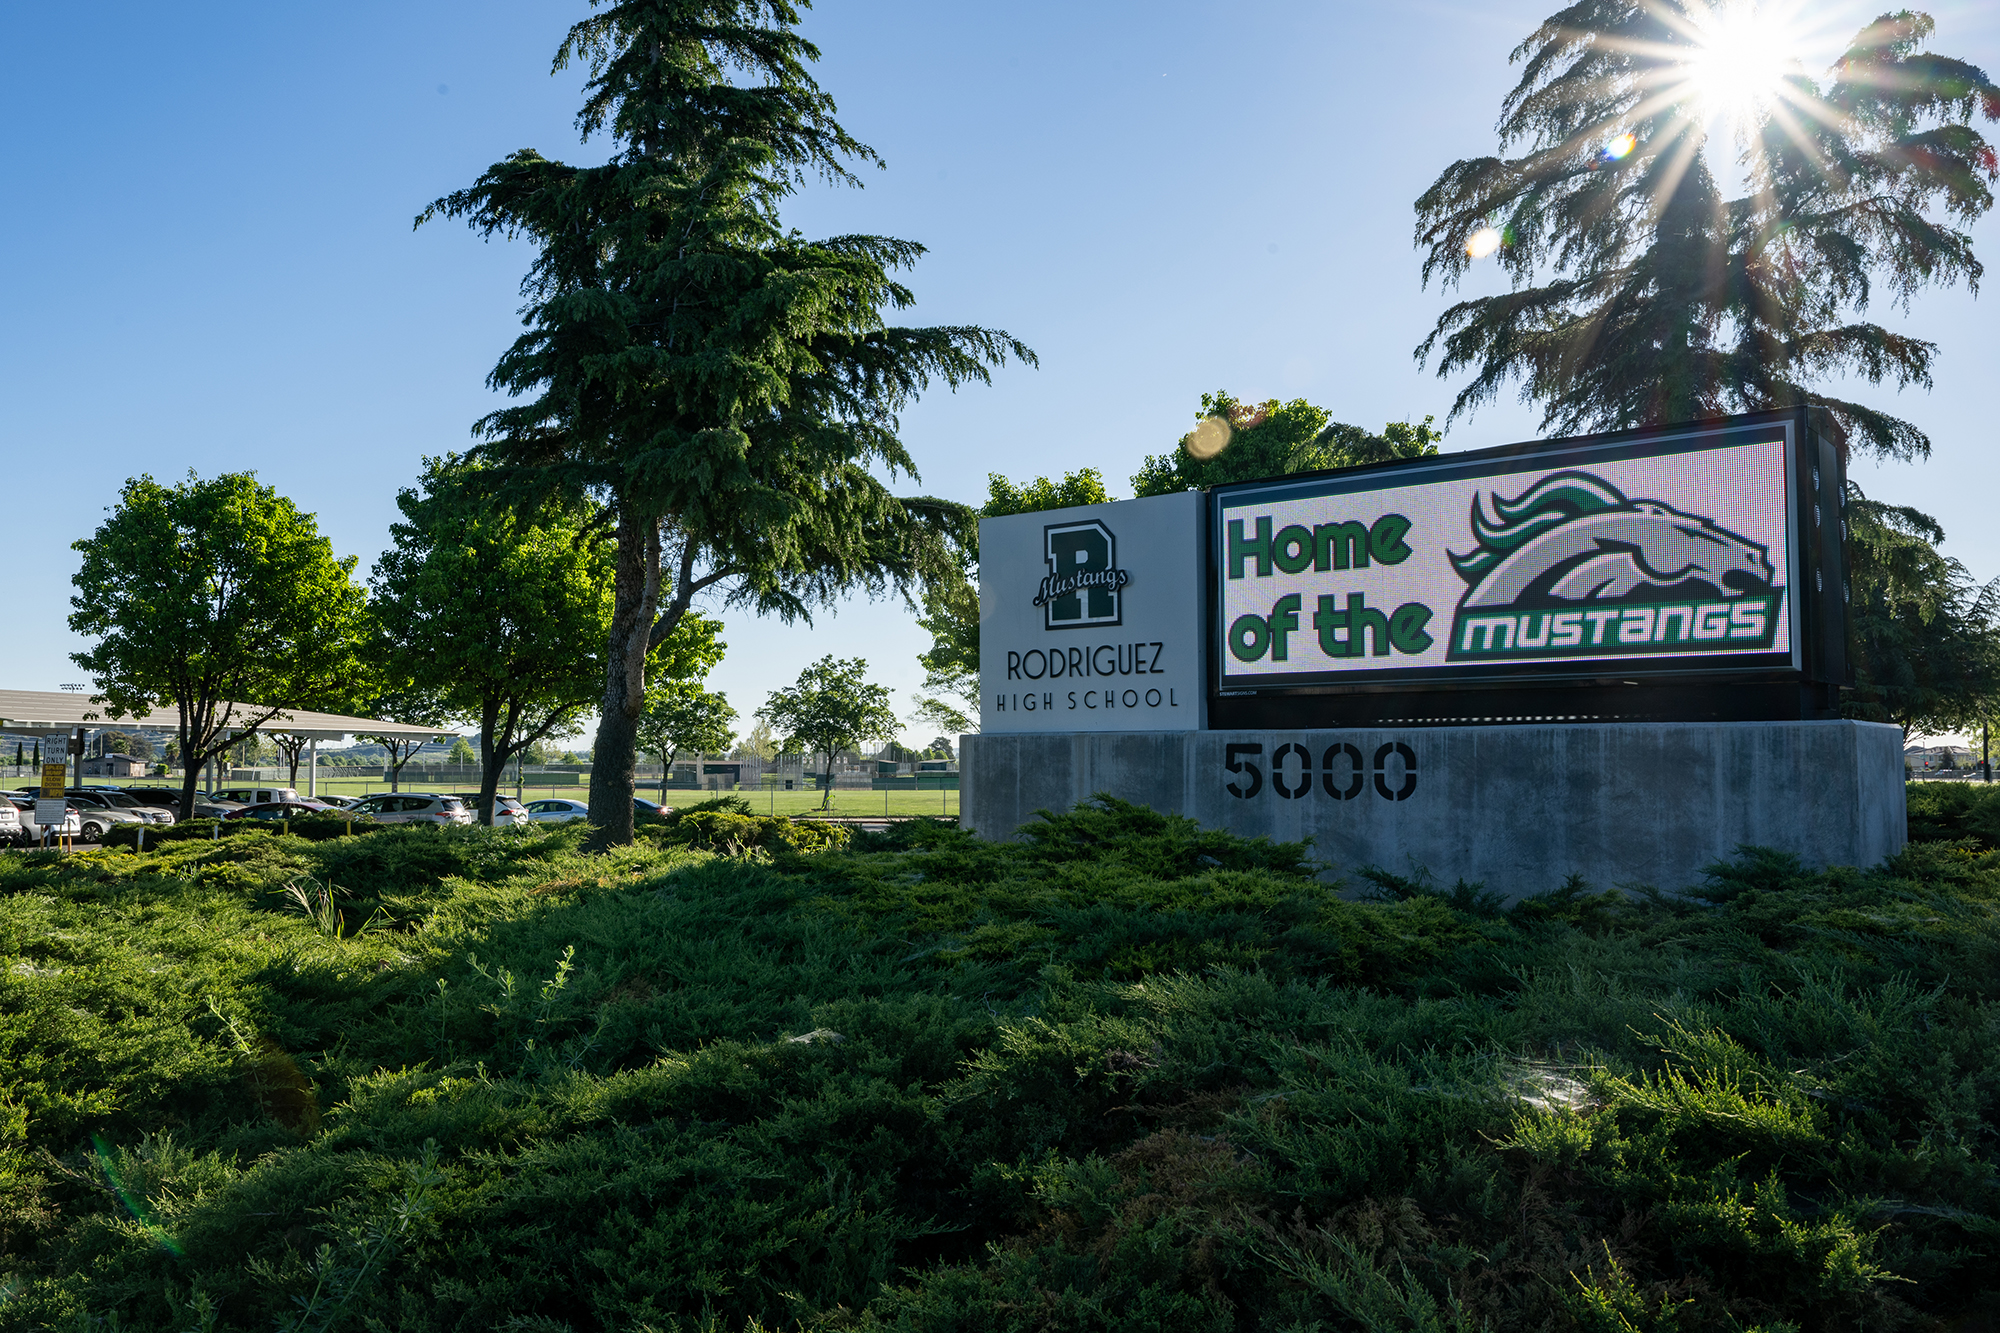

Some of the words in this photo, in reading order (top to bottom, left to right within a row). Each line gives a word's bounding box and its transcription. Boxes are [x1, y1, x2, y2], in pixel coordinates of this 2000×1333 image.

[1228, 513, 1412, 579] Home
[1033, 568, 1129, 607] Mustangs
[1044, 519, 1122, 631] R
[1228, 594, 1301, 662] of
[1314, 591, 1433, 658] the
[1008, 642, 1164, 680] RODRIGUEZ
[997, 692, 1052, 712] HIGH
[1068, 687, 1178, 710] SCHOOL
[46, 737, 67, 745] RIGHT
[46, 756, 64, 764] ONLY
[47, 747, 65, 755] TURN
[1225, 742, 1417, 801] 5000
[49, 789, 63, 797] MPH
